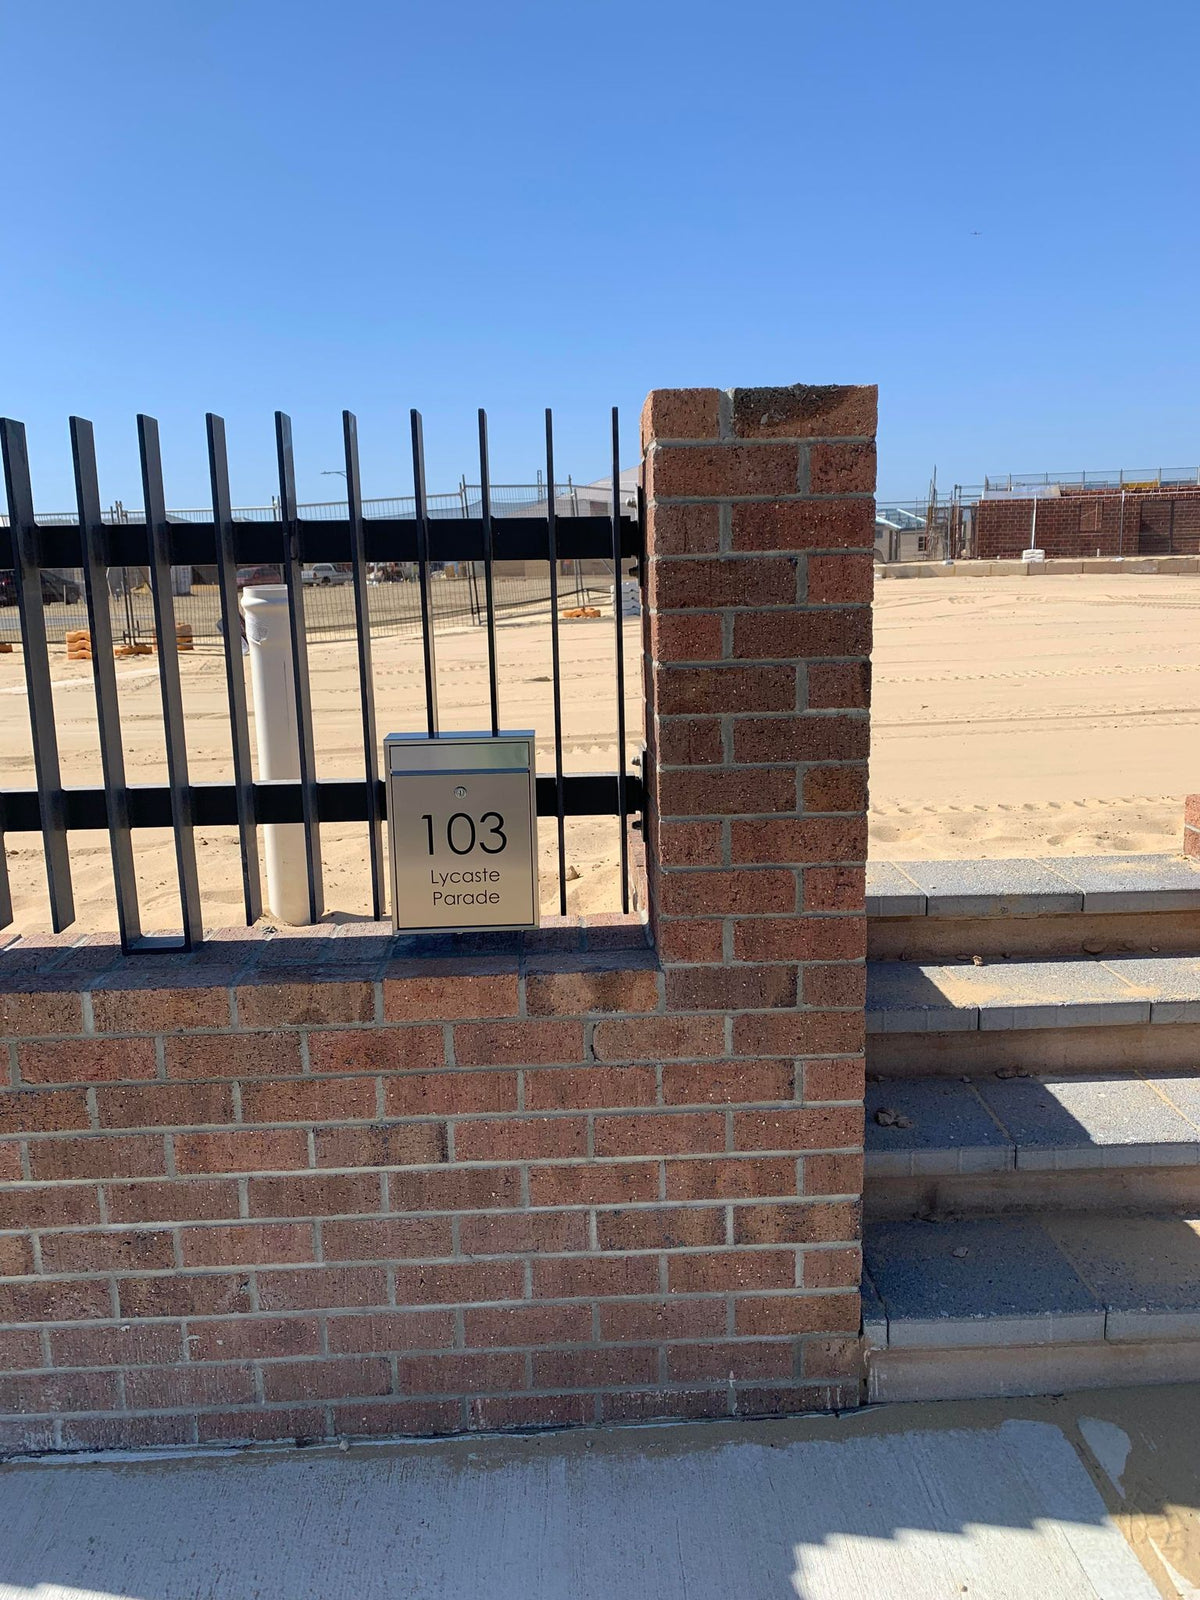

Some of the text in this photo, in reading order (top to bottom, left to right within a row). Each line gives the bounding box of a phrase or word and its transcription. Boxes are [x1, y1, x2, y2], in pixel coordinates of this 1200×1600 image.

[421, 811, 508, 856] 103
[430, 867, 501, 888] Lycaste
[432, 889, 501, 906] Parade
